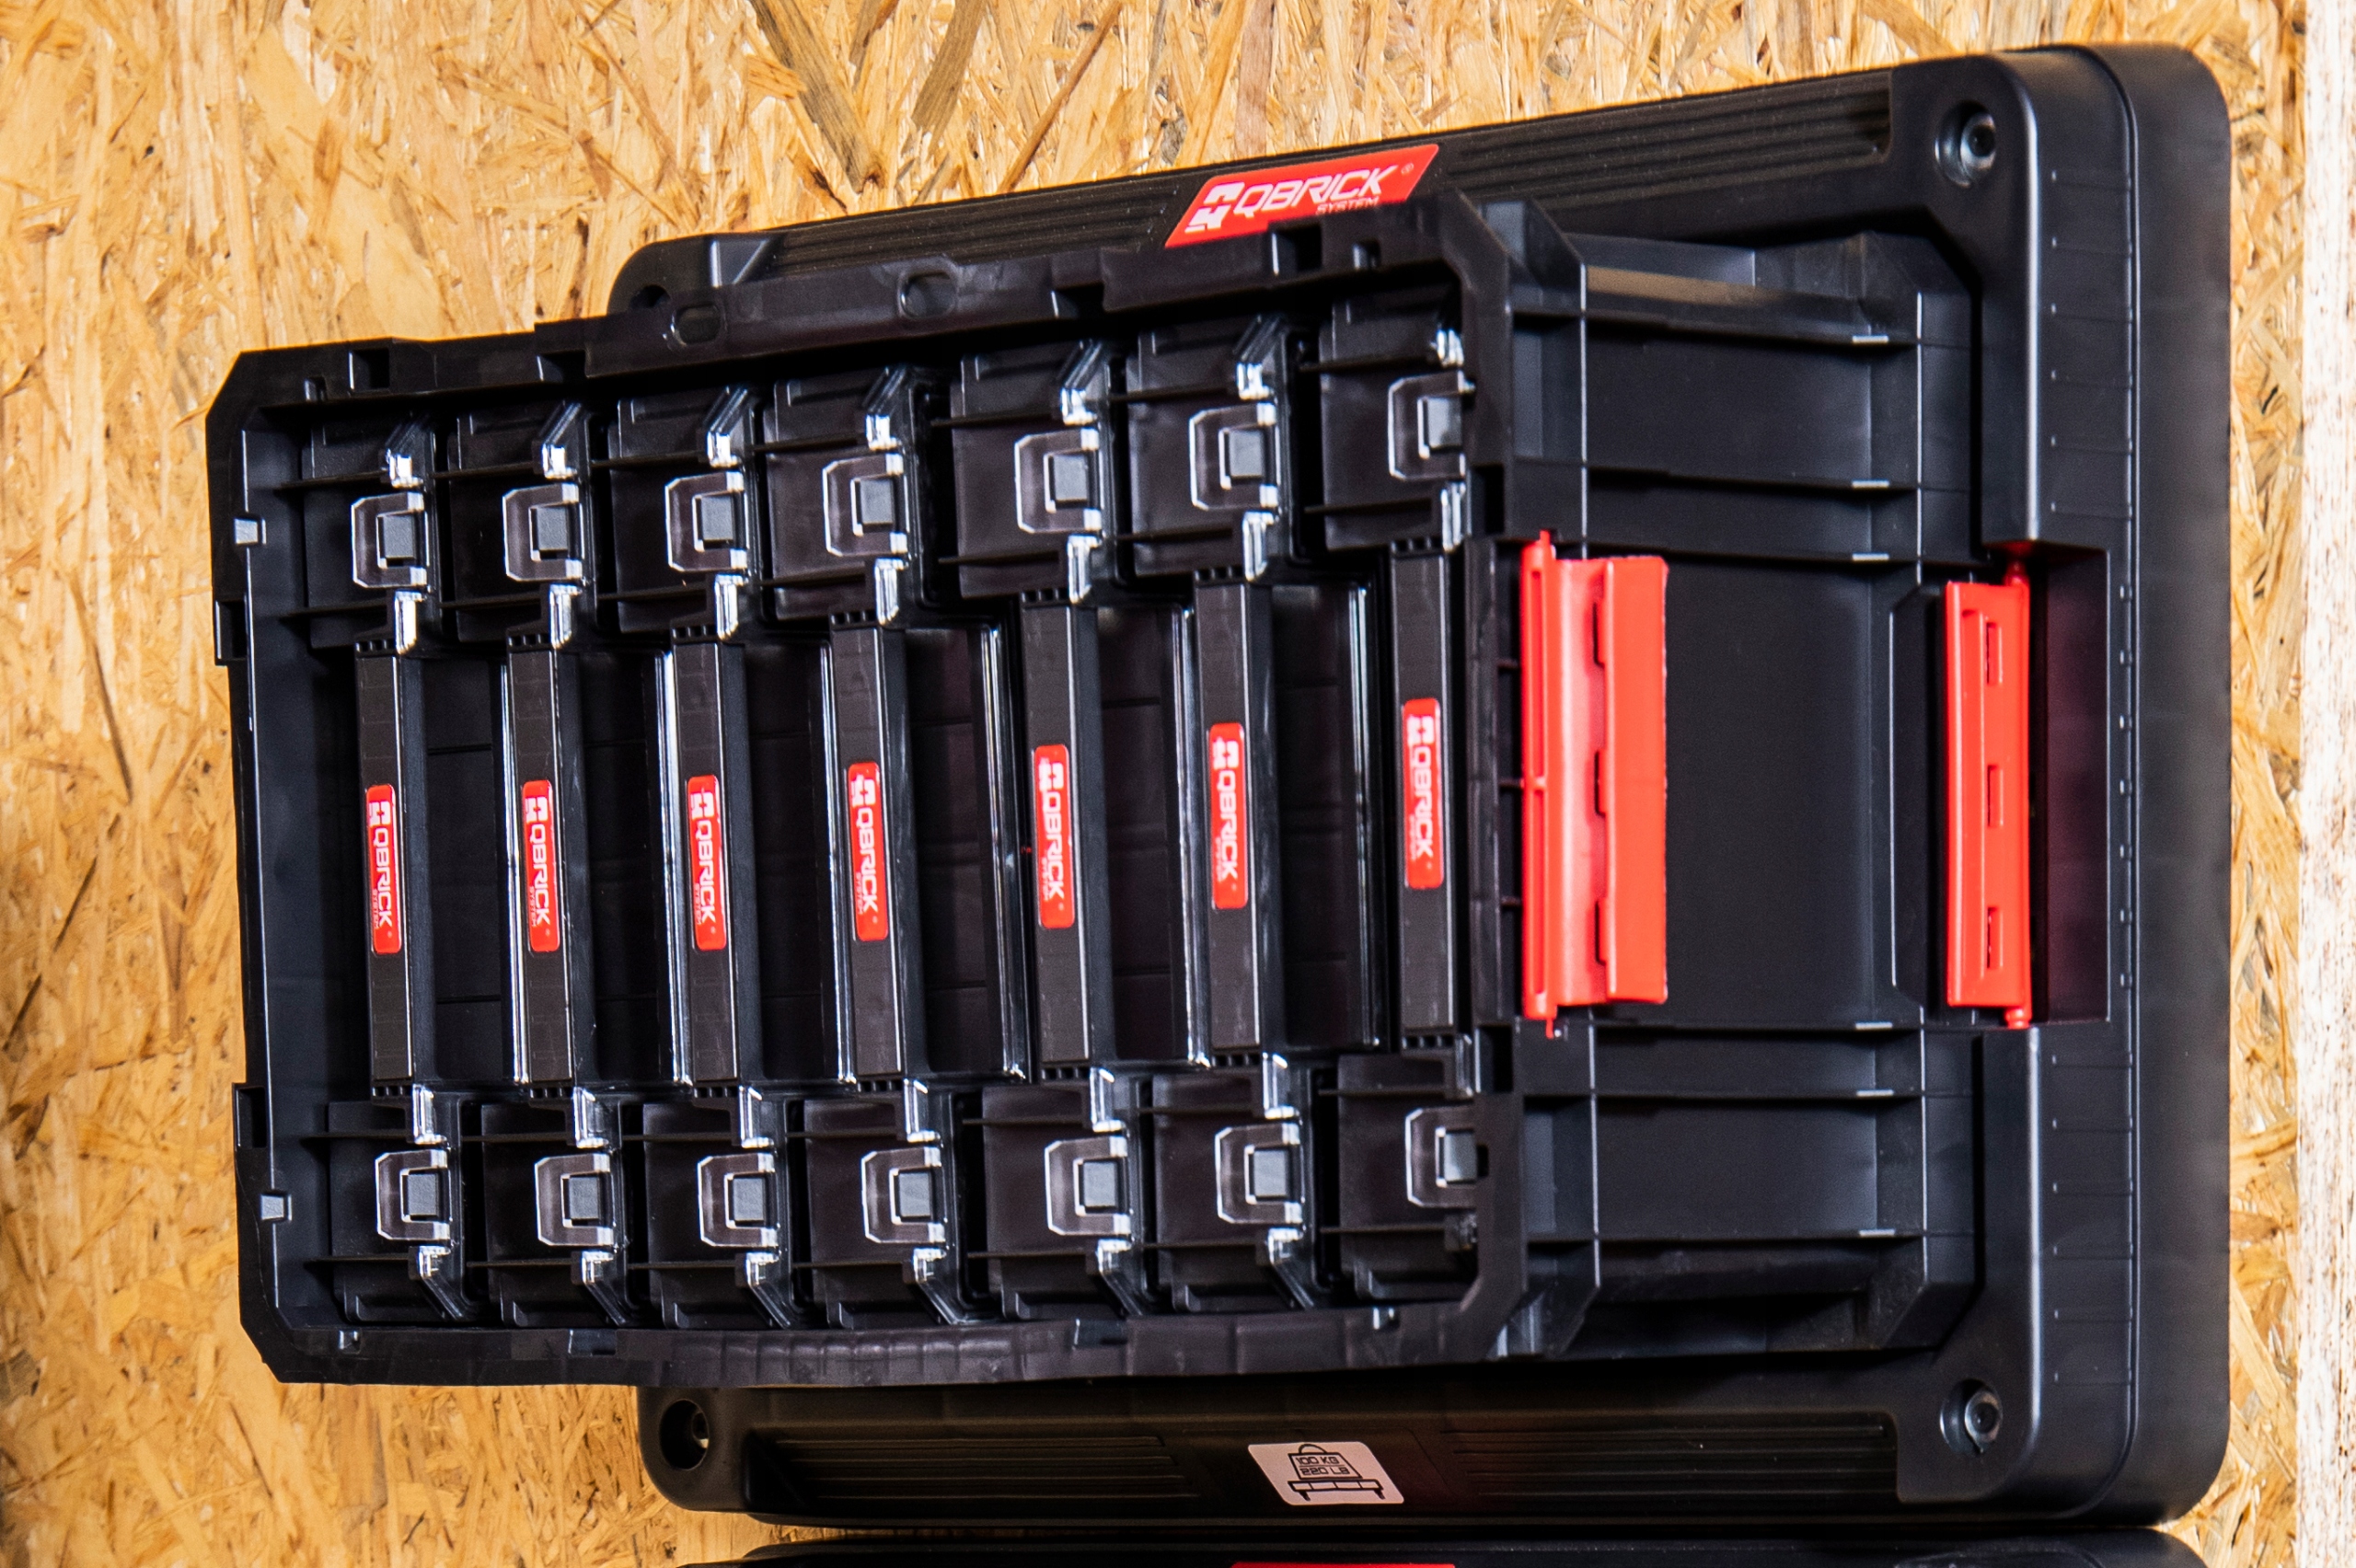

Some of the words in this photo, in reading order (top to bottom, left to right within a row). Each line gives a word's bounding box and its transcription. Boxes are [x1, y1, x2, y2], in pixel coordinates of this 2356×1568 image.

[1233, 164, 1399, 219] QBRICK
[1315, 196, 1380, 215] SYSTEM
[1042, 791, 1064, 899] QBRICK
[1217, 769, 1238, 880] QBRICK
[1412, 745, 1433, 858] QBRICK
[374, 827, 393, 928] QBRICK
[529, 824, 550, 926] QBRICK
[695, 819, 716, 924] QBRICK
[856, 807, 879, 913] QBRICK
[1296, 1457, 1319, 1465] 100
[1320, 1456, 1339, 1464] KG
[1299, 1467, 1329, 1476] 220
[1330, 1466, 1350, 1475] LB
